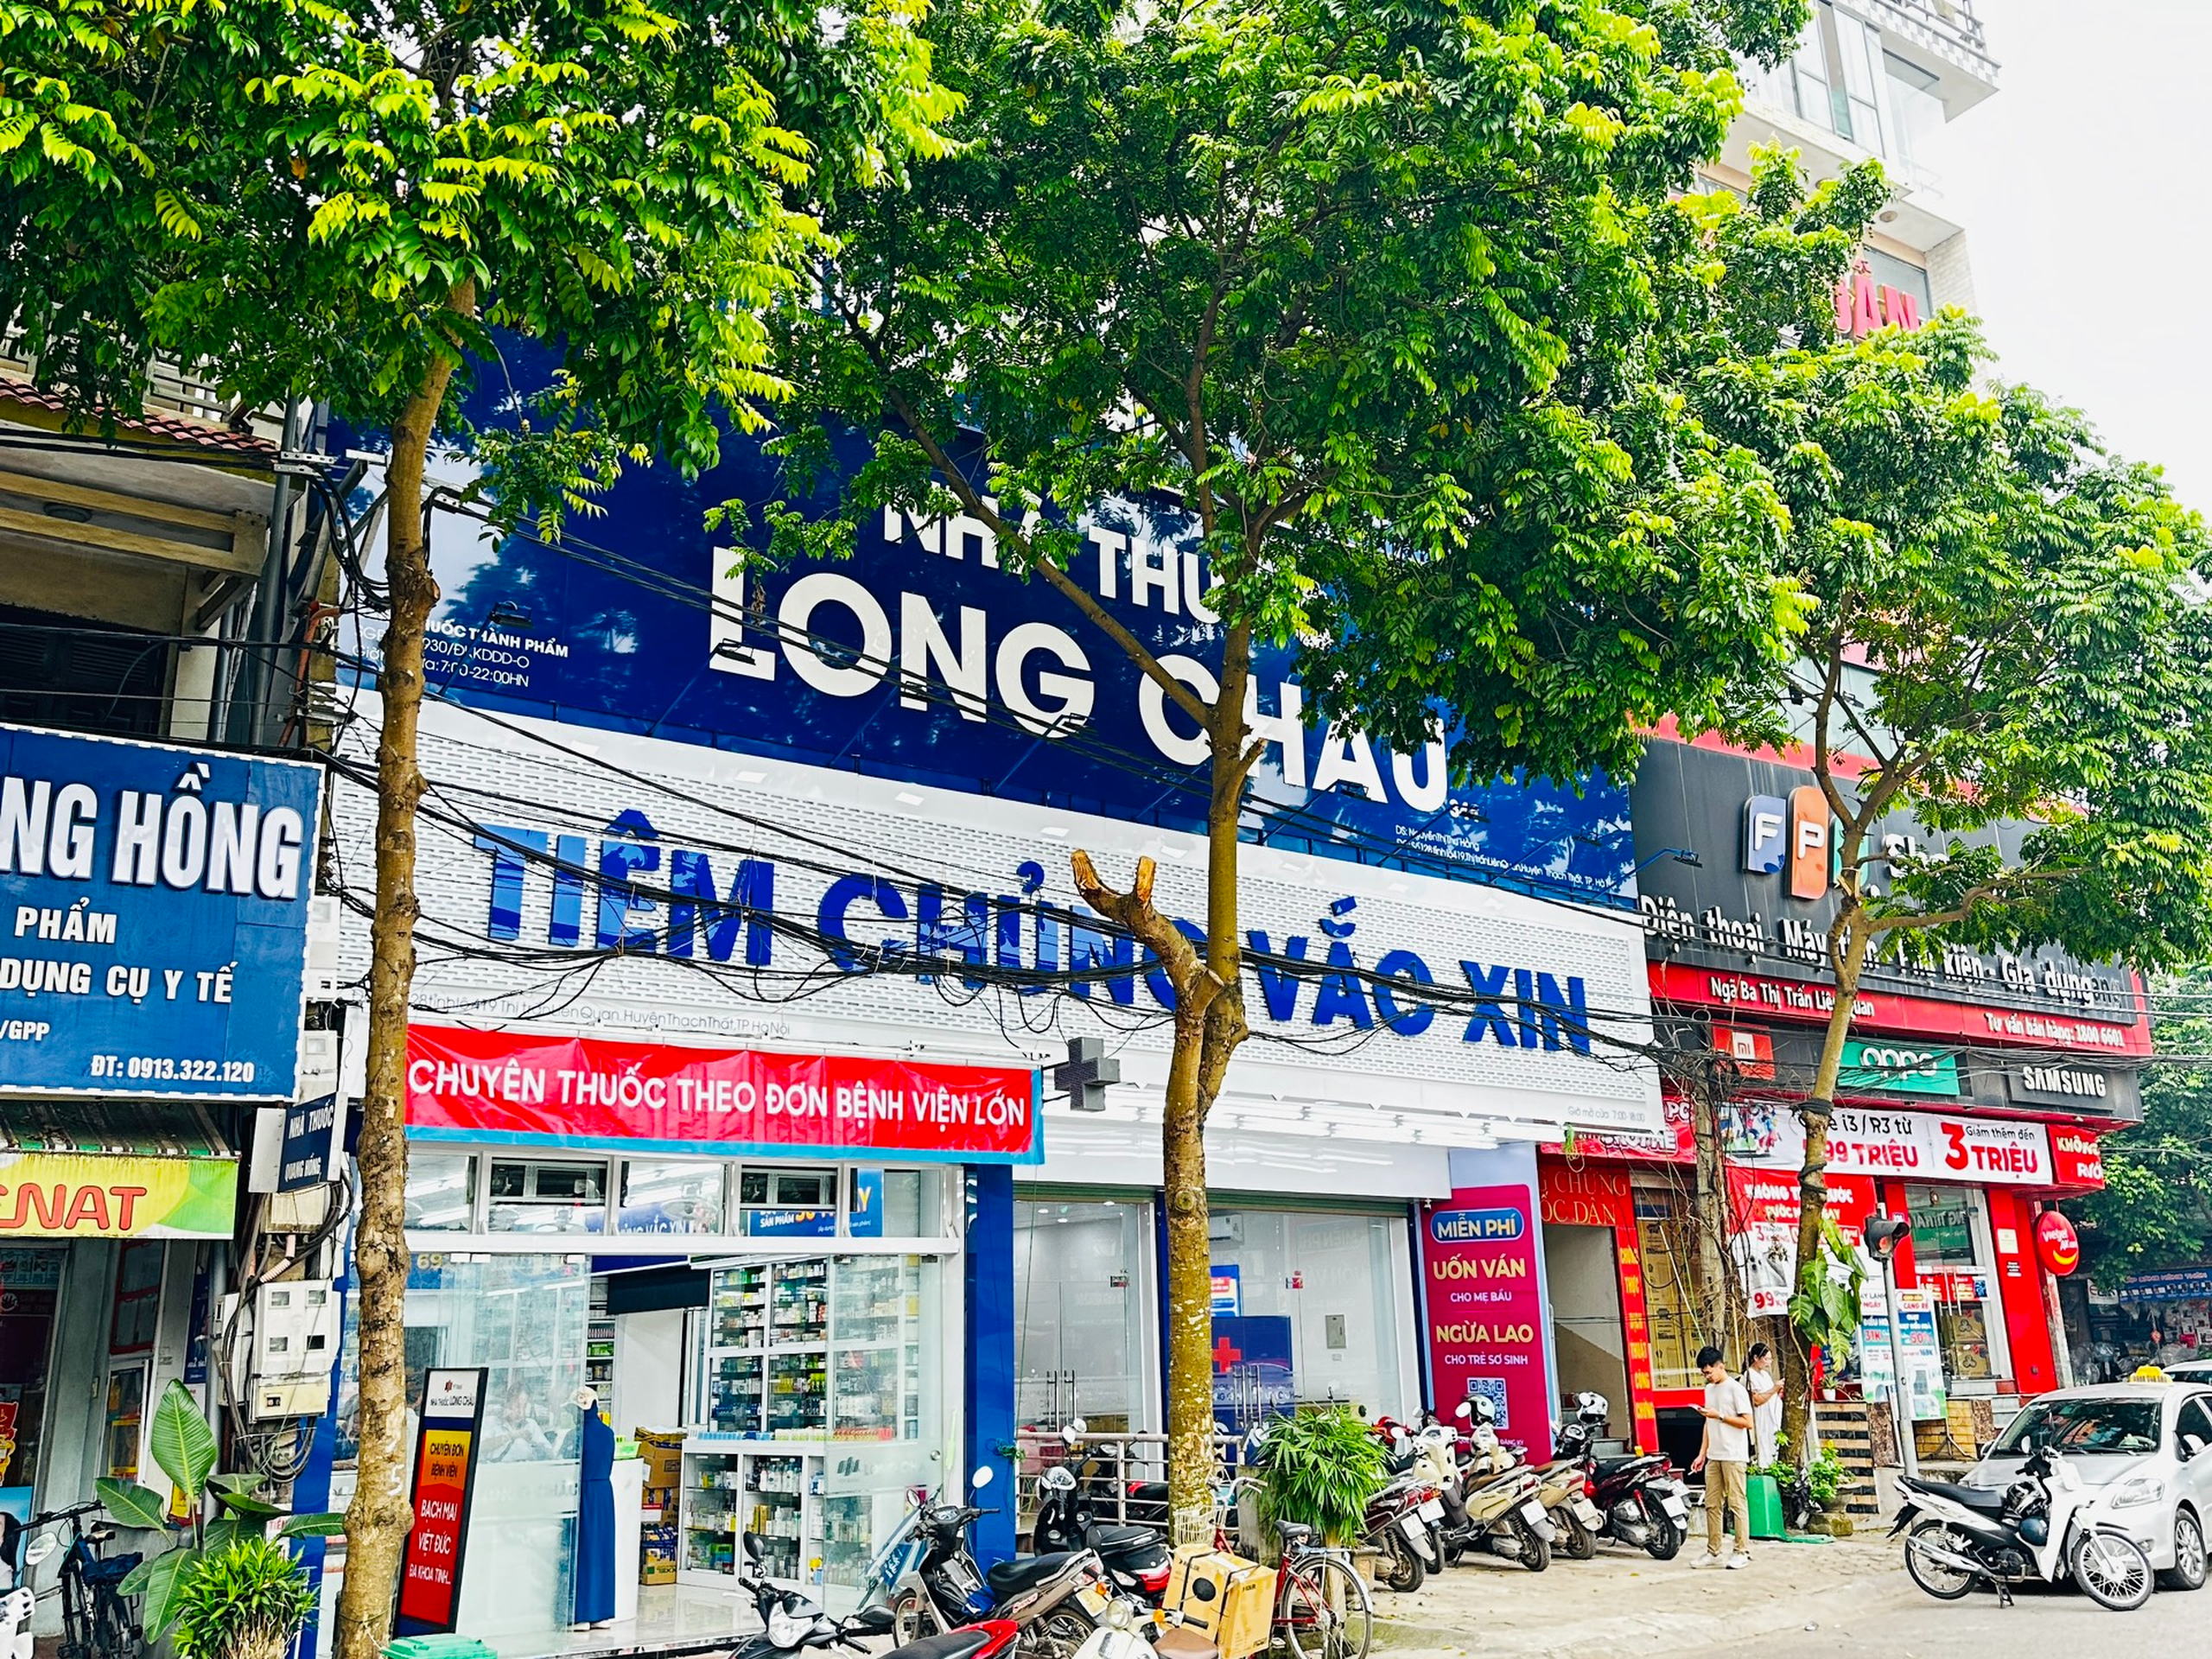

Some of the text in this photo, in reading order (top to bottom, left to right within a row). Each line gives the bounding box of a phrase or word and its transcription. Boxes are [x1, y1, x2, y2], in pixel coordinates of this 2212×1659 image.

[524, 637, 569, 658] PHẨM
[709, 546, 1095, 739] LONG
[111, 762, 303, 899] HỒNG
[14, 897, 118, 944] PHẨM
[473, 809, 774, 966] TIÊM
[1246, 895, 1434, 1037] VẮC
[1459, 959, 1591, 1056] XIN
[1640, 895, 1695, 953] Điện
[1705, 906, 1764, 964] thoại
[2001, 954, 2037, 994] Gia
[0, 957, 238, 1005] DỤNG CỤ Y TẾ
[1711, 976, 1738, 1003] Ngã
[1738, 980, 1758, 1001] Ba
[1759, 982, 1782, 1010] Thị
[1784, 983, 1814, 1009] Trấn
[1850, 1000, 1875, 1020] uan
[1985, 1012, 2003, 1033] Tư
[2005, 1012, 2024, 1035] vấn
[2025, 1016, 2045, 1038] bán
[2045, 1020, 2074, 1046] hàng:
[2075, 1024, 2100, 1044] 1800
[91, 1054, 255, 1084] ĐT: 0913.322.120
[1860, 1046, 1938, 1080] oppo
[408, 1057, 1025, 1133] CHUYÊN THUỐC THEO ĐƠN BỆNH VIỆN LỚN
[2023, 1065, 2107, 1098] SAMSUNG
[308, 1098, 334, 1133] THUỐC
[1841, 1113, 1859, 1132] i3
[1869, 1116, 1890, 1135] R3
[1894, 1116, 1912, 1135] từ
[1941, 1122, 1967, 1170] 3
[1966, 1124, 2035, 1141] Giảm thêm đến
[1851, 1138, 1919, 1173] TRIỆU
[1971, 1141, 2038, 1179] TRIỆU
[1573, 1197, 1616, 1225] DÂN
[1827, 1185, 1854, 1204] ƯỚC
[1437, 1212, 1516, 1239] MIỄN PHÍ
[1433, 1253, 1526, 1280] UỐN VÁN
[1450, 1287, 1512, 1306] CHO MẸ BẦU
[1435, 1320, 1534, 1344] NGỪA LAO
[1445, 1354, 1466, 1366] CHO
[1467, 1351, 1486, 1366] TRẺ
[1504, 1354, 1529, 1366] SINH
[421, 1499, 458, 1524] BẠCH MAI
[418, 1528, 451, 1557] VIỆT ĐỨC
[417, 1565, 434, 1582] KHOA
